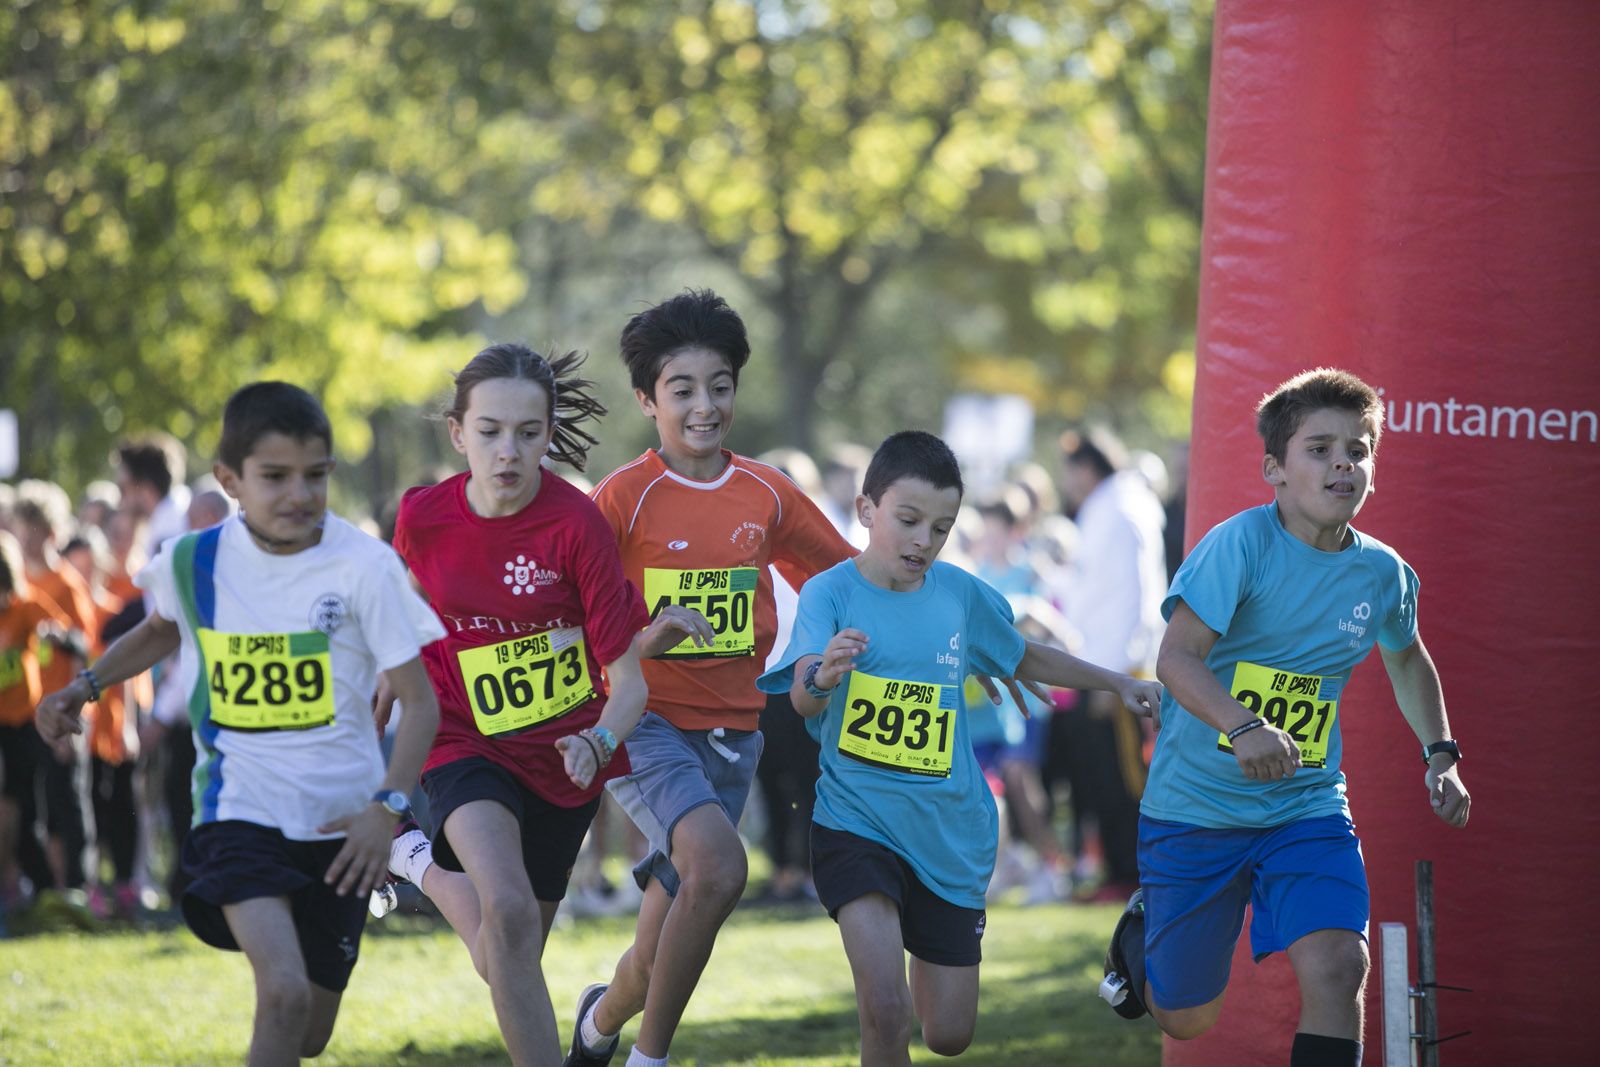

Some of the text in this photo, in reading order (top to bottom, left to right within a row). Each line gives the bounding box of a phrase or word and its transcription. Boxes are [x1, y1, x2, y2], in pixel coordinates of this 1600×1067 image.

[1377, 387, 1599, 443] untamen
[679, 571, 693, 590] 19
[696, 570, 729, 590] CROS
[228, 635, 242, 656] 19
[494, 644, 509, 664] 19
[513, 634, 550, 660] CROS
[210, 659, 325, 706] 4289
[474, 645, 582, 716] 0673
[883, 681, 900, 700] 19
[900, 683, 935, 705] CROS
[1270, 672, 1288, 692] 19
[1287, 675, 1320, 696] CROS
[847, 698, 950, 753] 2931
[1235, 689, 1331, 743] 2921
